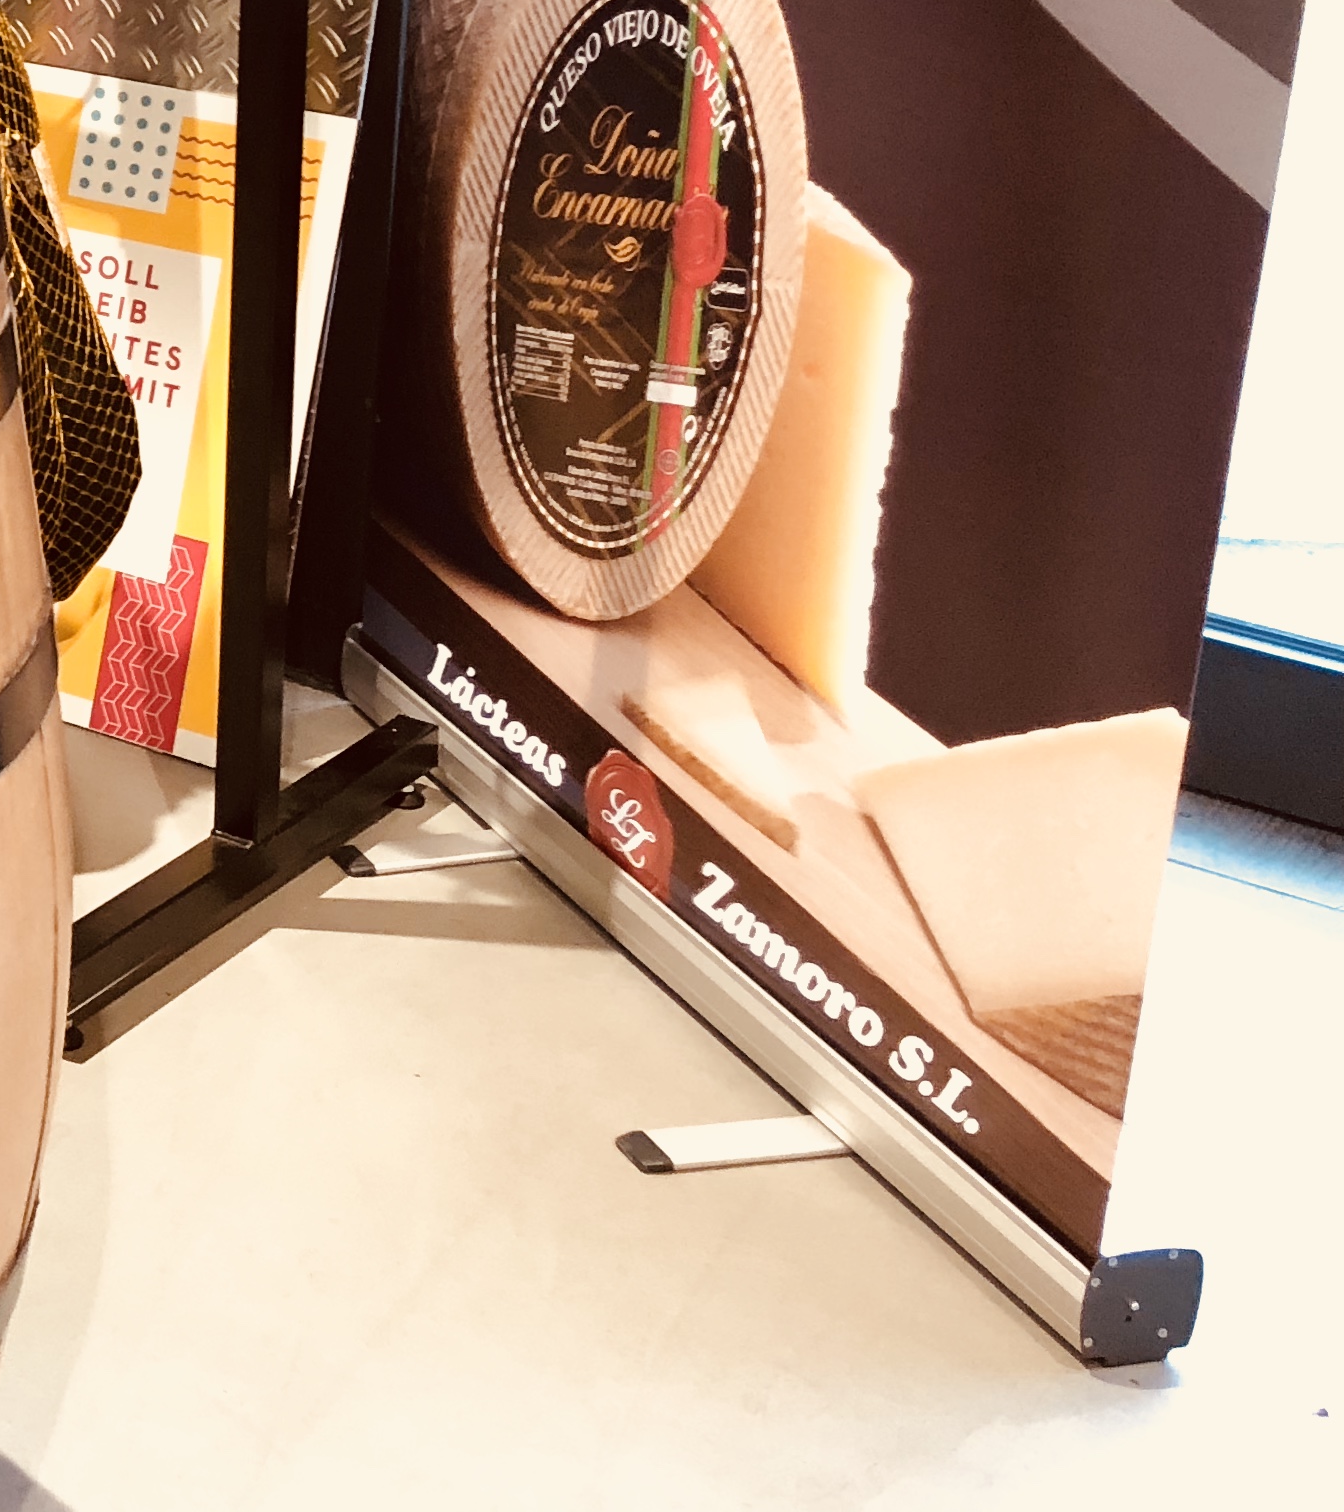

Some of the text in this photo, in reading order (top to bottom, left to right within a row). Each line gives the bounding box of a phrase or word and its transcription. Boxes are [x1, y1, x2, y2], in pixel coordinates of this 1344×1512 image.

[540, 8, 737, 152] QUESO VIEJO DE OVEJA
[583, 104, 680, 182] Doña
[533, 152, 680, 232] Encarnac
[77, 250, 160, 290] SOLL
[96, 291, 148, 324] EIB
[111, 332, 182, 371] TES
[124, 373, 181, 409] MIT
[425, 643, 568, 788] Lácteas
[689, 860, 981, 1136] Zamoro S.L.
